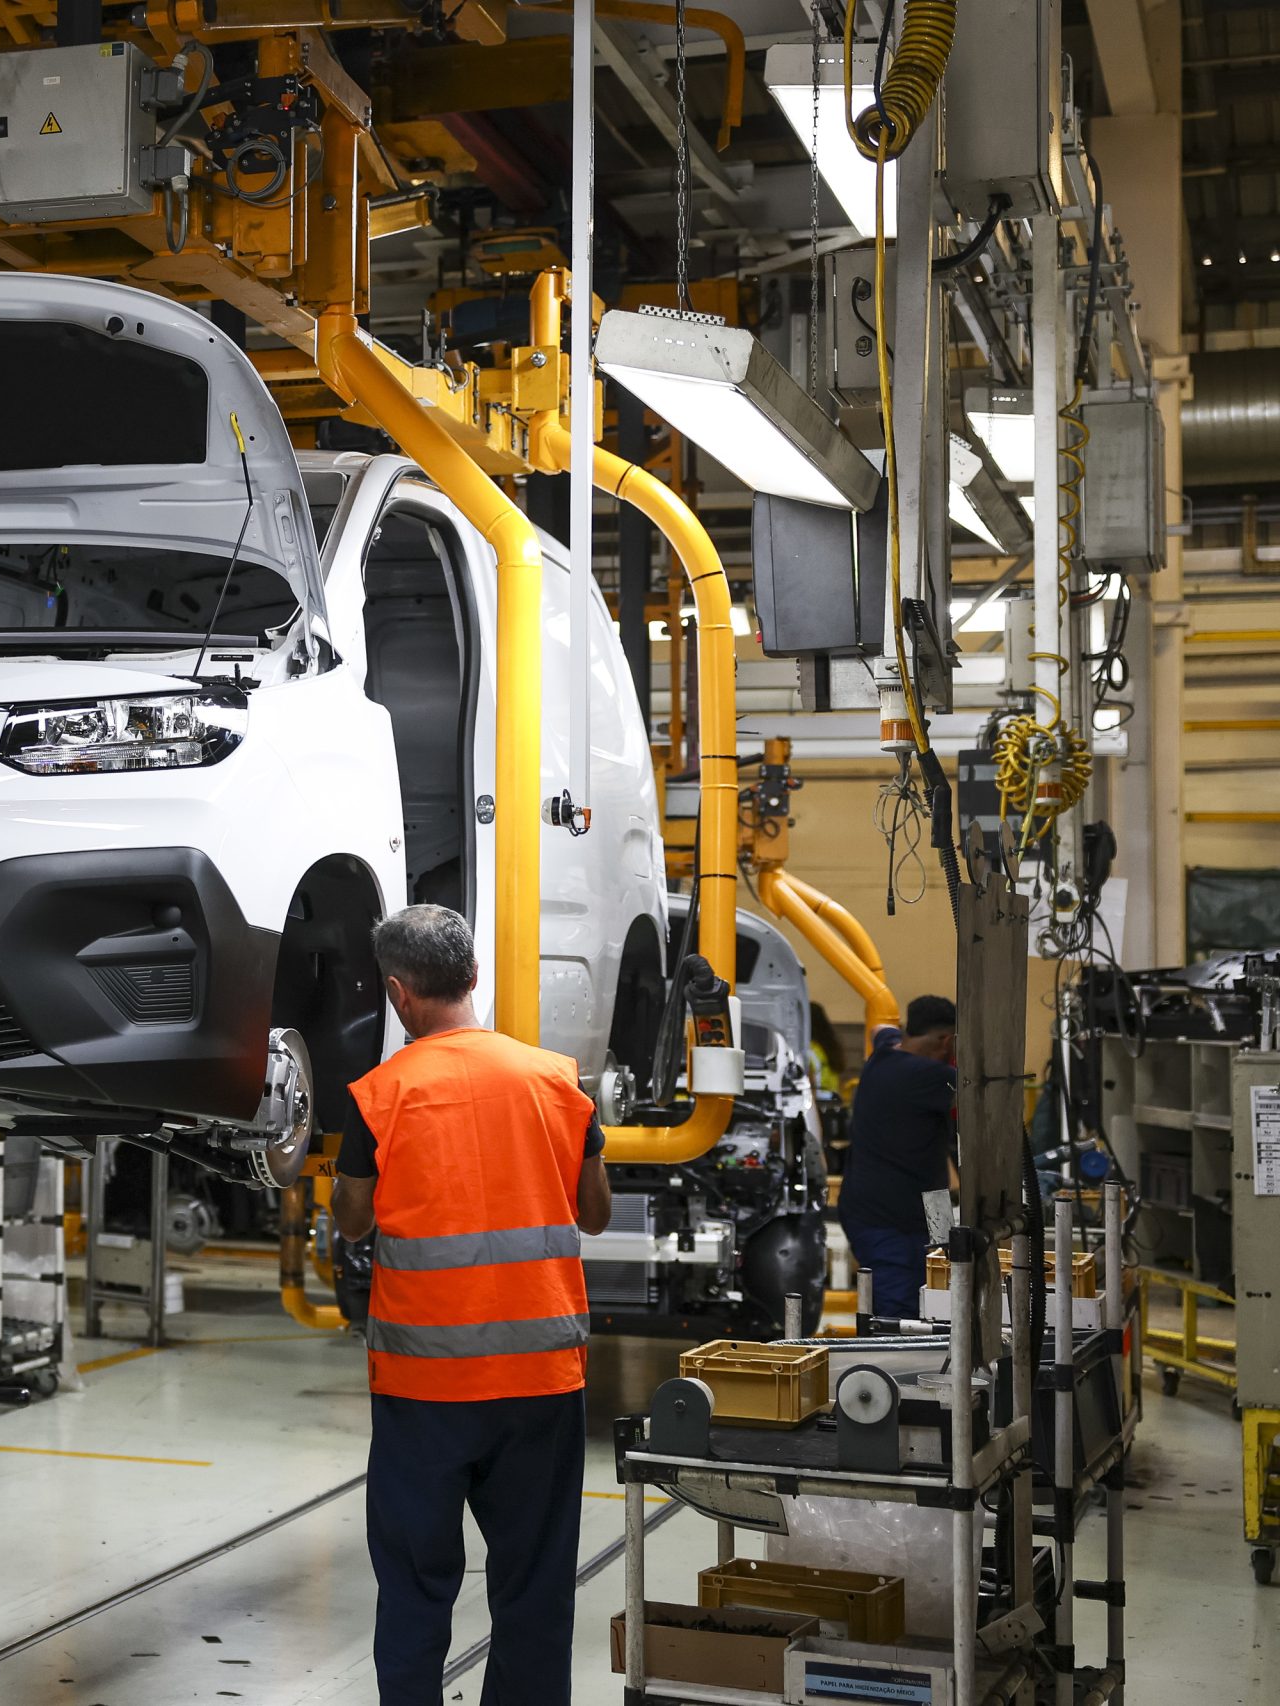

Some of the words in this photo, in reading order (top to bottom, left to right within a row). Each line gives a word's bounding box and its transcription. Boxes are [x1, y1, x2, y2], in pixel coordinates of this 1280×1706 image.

[820, 1680, 837, 1688] PAPEL
[838, 1682, 854, 1690] PARA
[896, 1688, 916, 1697] MEIOS
